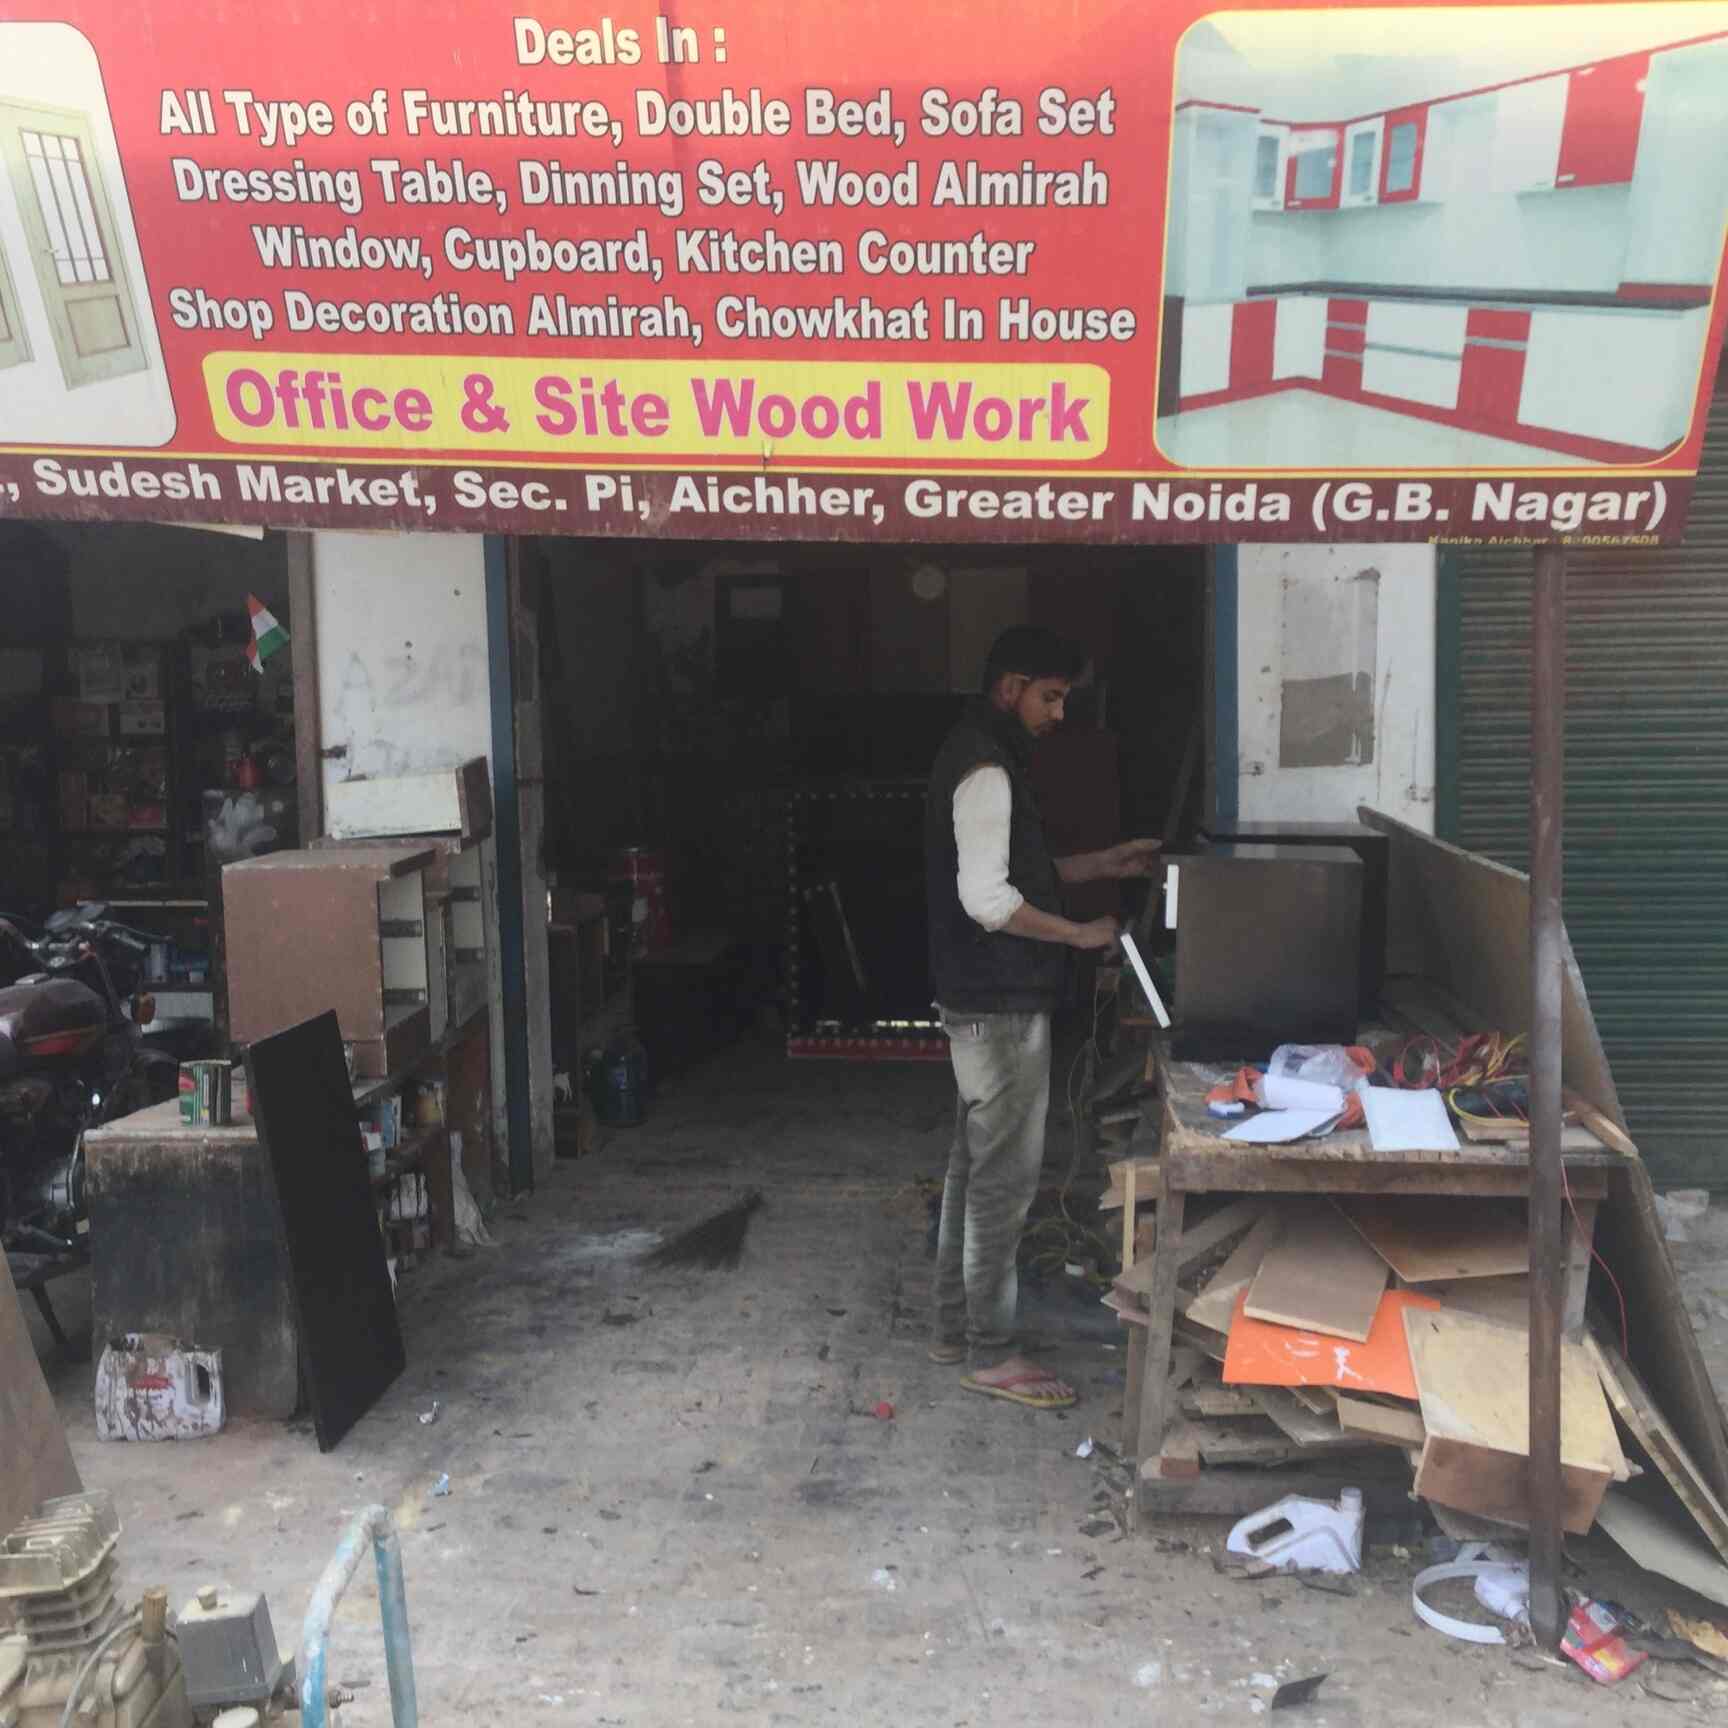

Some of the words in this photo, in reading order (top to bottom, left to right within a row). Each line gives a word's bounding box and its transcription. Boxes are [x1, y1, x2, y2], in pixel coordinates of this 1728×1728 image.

[514, 16, 641, 65] Deals
[655, 15, 699, 64] In
[160, 89, 216, 135] All
[223, 89, 334, 146] Type
[346, 89, 389, 135] of
[402, 89, 623, 146] Furniture,
[635, 88, 792, 136] Double
[804, 88, 905, 146] Bed,
[920, 88, 1023, 136] Sofa
[1036, 86, 1116, 136] Set
[171, 157, 363, 213] Dressing
[370, 159, 507, 213] Table,
[518, 159, 684, 216] Dinning
[697, 159, 785, 214] Set,
[796, 160, 918, 206] Wood
[932, 160, 1108, 206] Almirah
[252, 225, 433, 278] Window,
[444, 227, 664, 282] Cupboard,
[675, 229, 844, 274] Kitchen
[857, 229, 1035, 276] Counter
[168, 288, 274, 340] Shop
[283, 289, 515, 336] Decoration
[526, 293, 703, 346] Almirah,
[715, 295, 930, 340] Chowkhat
[943, 298, 984, 340] In
[998, 298, 1137, 341] House
[226, 367, 433, 432] Office
[460, 373, 510, 433] &
[534, 376, 671, 437] Site
[691, 378, 883, 440] Wood
[907, 381, 1091, 442] Work
[33, 458, 221, 501] Sudesh
[236, 464, 437, 514] Market,
[453, 470, 568, 511] Sec.
[585, 475, 652, 521] Pi,
[669, 476, 886, 524] Aichher,
[904, 479, 1115, 521] Greater
[1131, 482, 1292, 522] Noida
[1311, 482, 1450, 530] (G.B.
[1471, 481, 1669, 530] Nagar)
